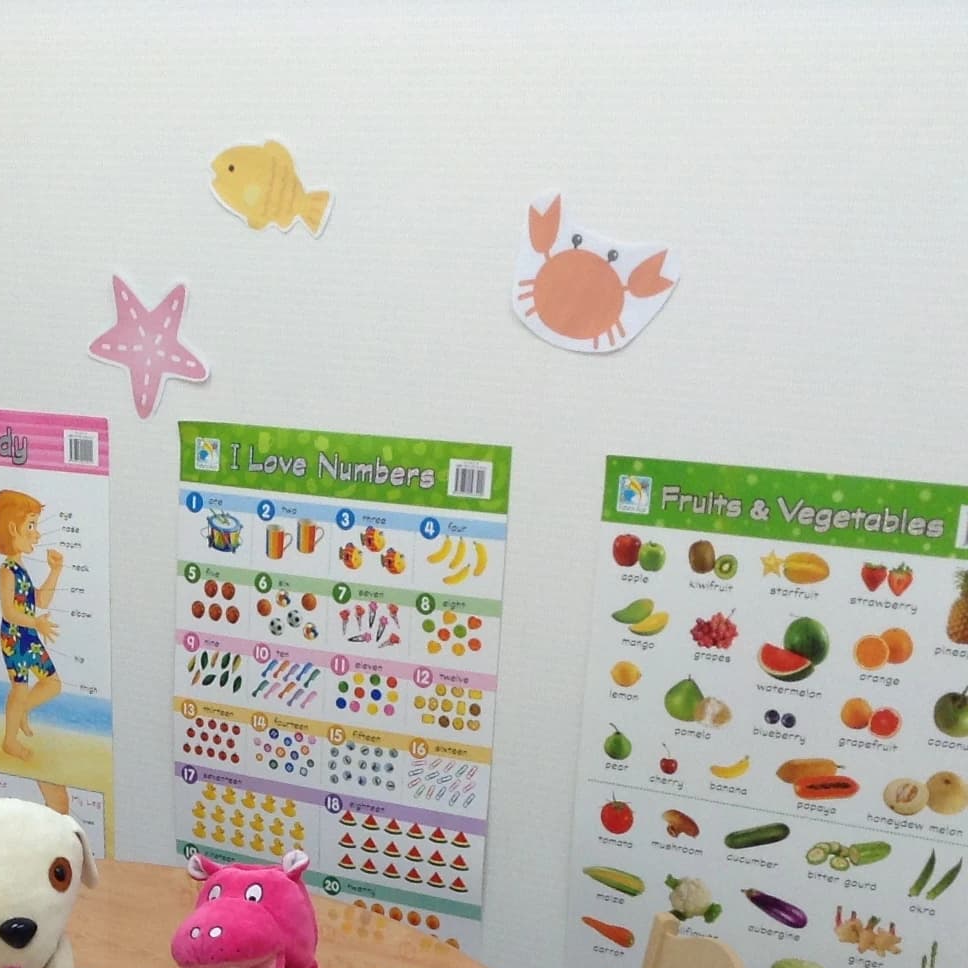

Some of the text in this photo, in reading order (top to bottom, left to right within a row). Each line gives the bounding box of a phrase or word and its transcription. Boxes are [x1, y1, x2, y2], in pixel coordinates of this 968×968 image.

[230, 443, 435, 489] I Love Numbers
[191, 496, 197, 508] 1
[262, 504, 271, 518] 2
[661, 485, 944, 538] Fruits & Vegetables
[341, 512, 350, 526] 3
[425, 521, 434, 536] 4
[188, 566, 196, 579] 5
[621, 573, 649, 584] apple
[259, 576, 268, 590] 6
[338, 586, 347, 600] 7
[770, 587, 819, 599] starfruit
[421, 596, 431, 611] 8
[850, 597, 918, 615] strawberry
[187, 635, 195, 648] 9
[621, 638, 655, 650] mango
[255, 646, 269, 660] 10
[694, 651, 731, 663] grapes
[935, 646, 968, 659] pinea
[334, 658, 345, 671] 11
[417, 670, 430, 684] 12
[859, 673, 900, 687] orange
[609, 691, 639, 701] lemon
[757, 684, 822, 699] watermelon
[183, 702, 195, 715] 13
[253, 714, 266, 728] 14
[329, 729, 343, 741] 15
[675, 728, 712, 740] pomelo
[753, 728, 806, 745] blueberry
[412, 742, 425, 755] 16
[839, 737, 898, 751] grapefruit
[928, 738, 968, 751] coconu
[183, 769, 196, 780] 17
[649, 774, 683, 790] cherry
[710, 782, 748, 795] banana
[326, 797, 340, 810] 18
[797, 801, 837, 815] papaya
[867, 813, 963, 836] honeydew melon
[651, 840, 703, 856] mushroom
[727, 854, 779, 869] cucumber
[325, 880, 340, 891] 20
[844, 878, 877, 891] gourd
